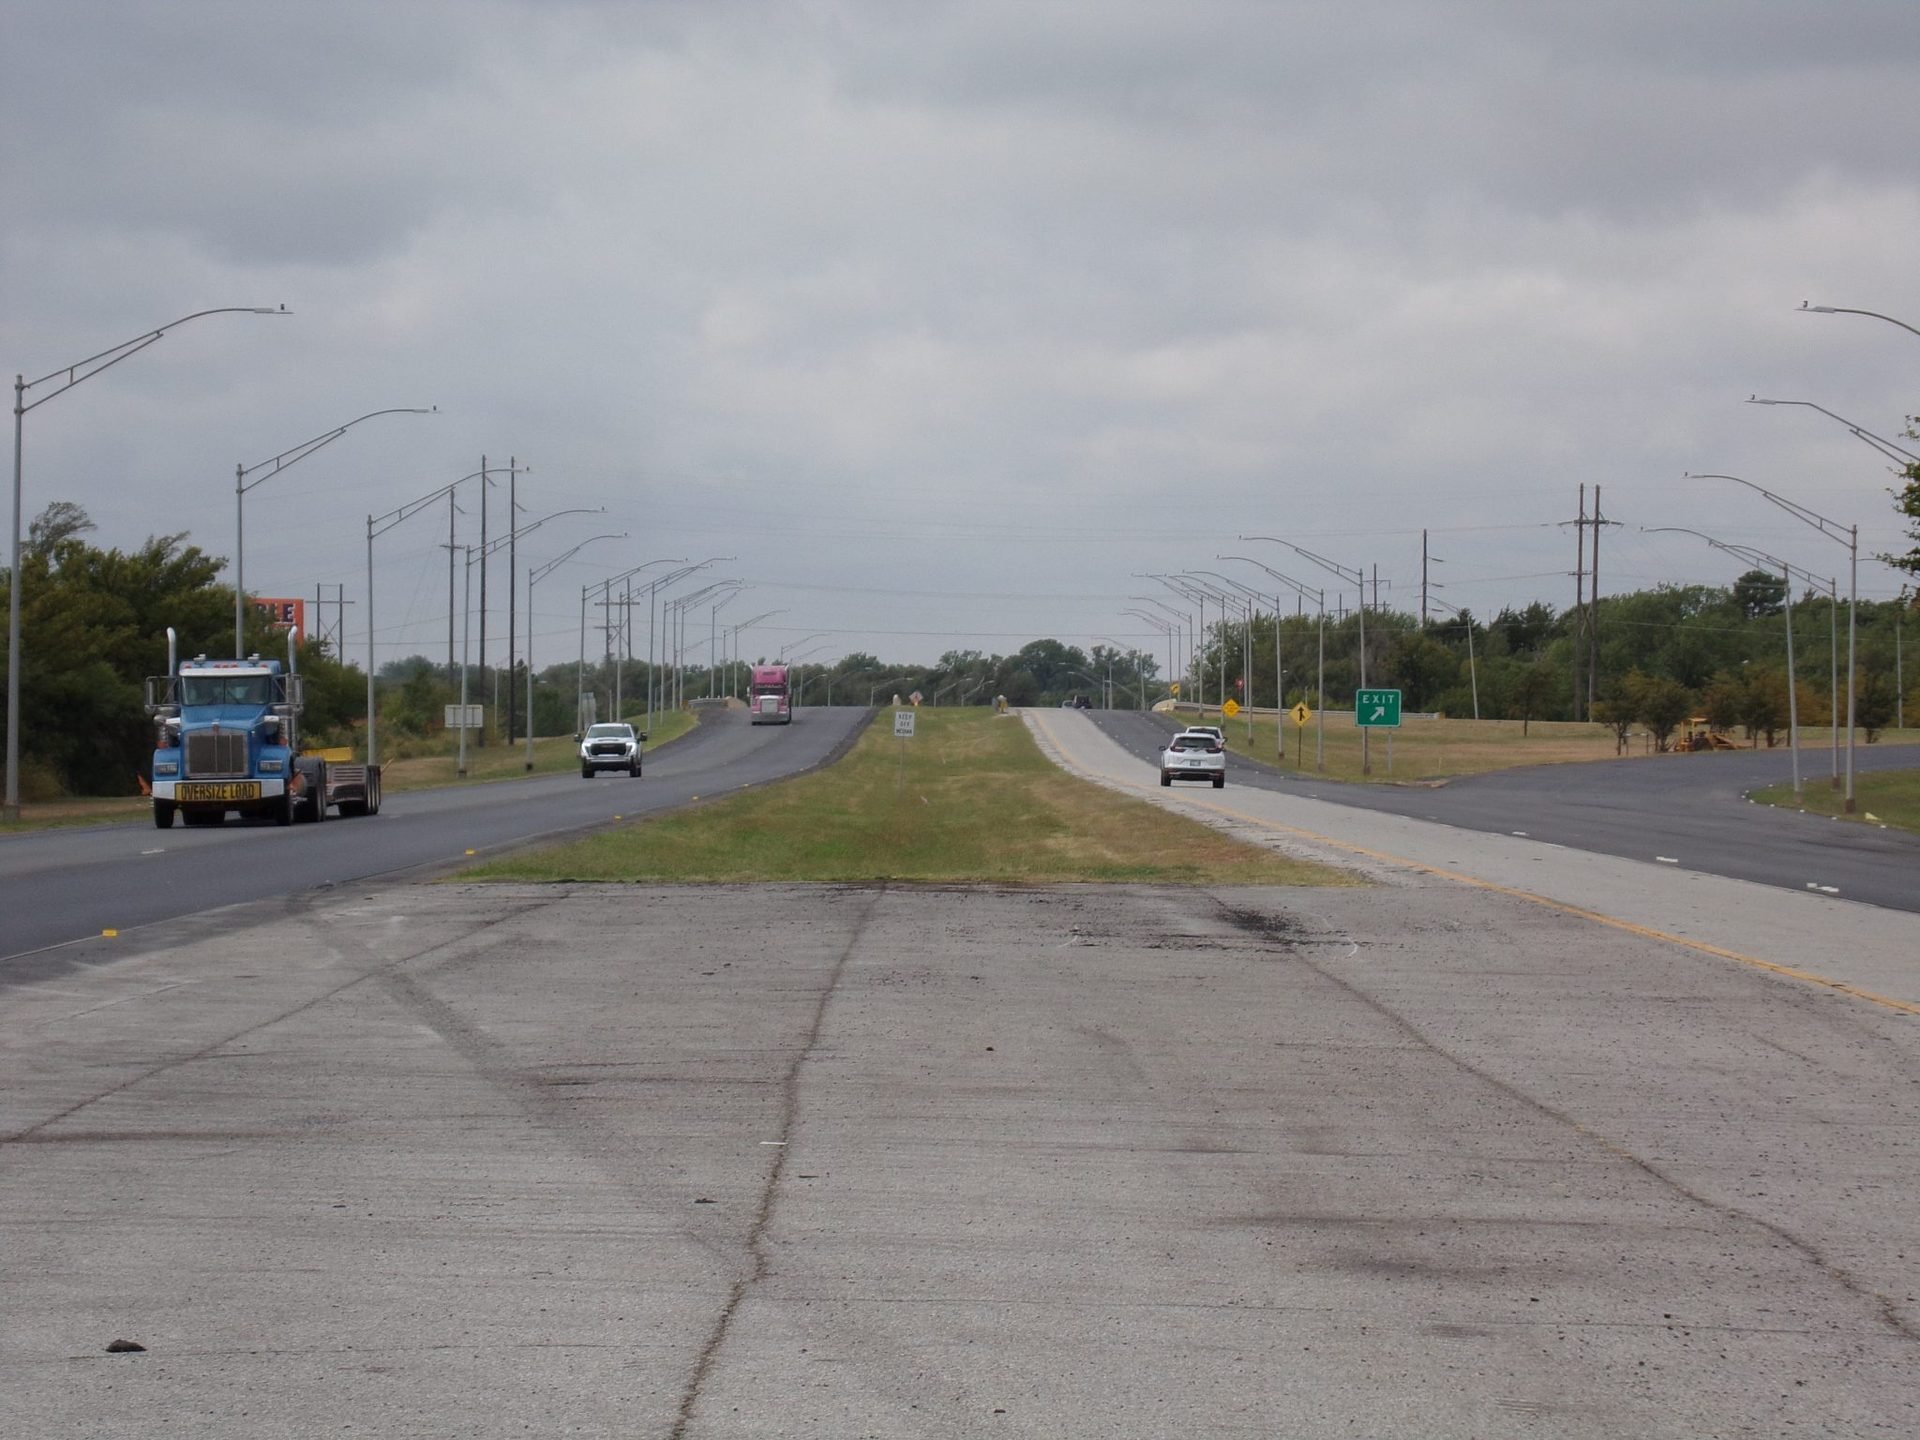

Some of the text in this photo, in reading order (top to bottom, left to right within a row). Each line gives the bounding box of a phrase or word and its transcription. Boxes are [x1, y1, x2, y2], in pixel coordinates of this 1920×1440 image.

[1362, 694, 1395, 704] EXIT
[180, 783, 255, 800] OVERSIZE LOAD
